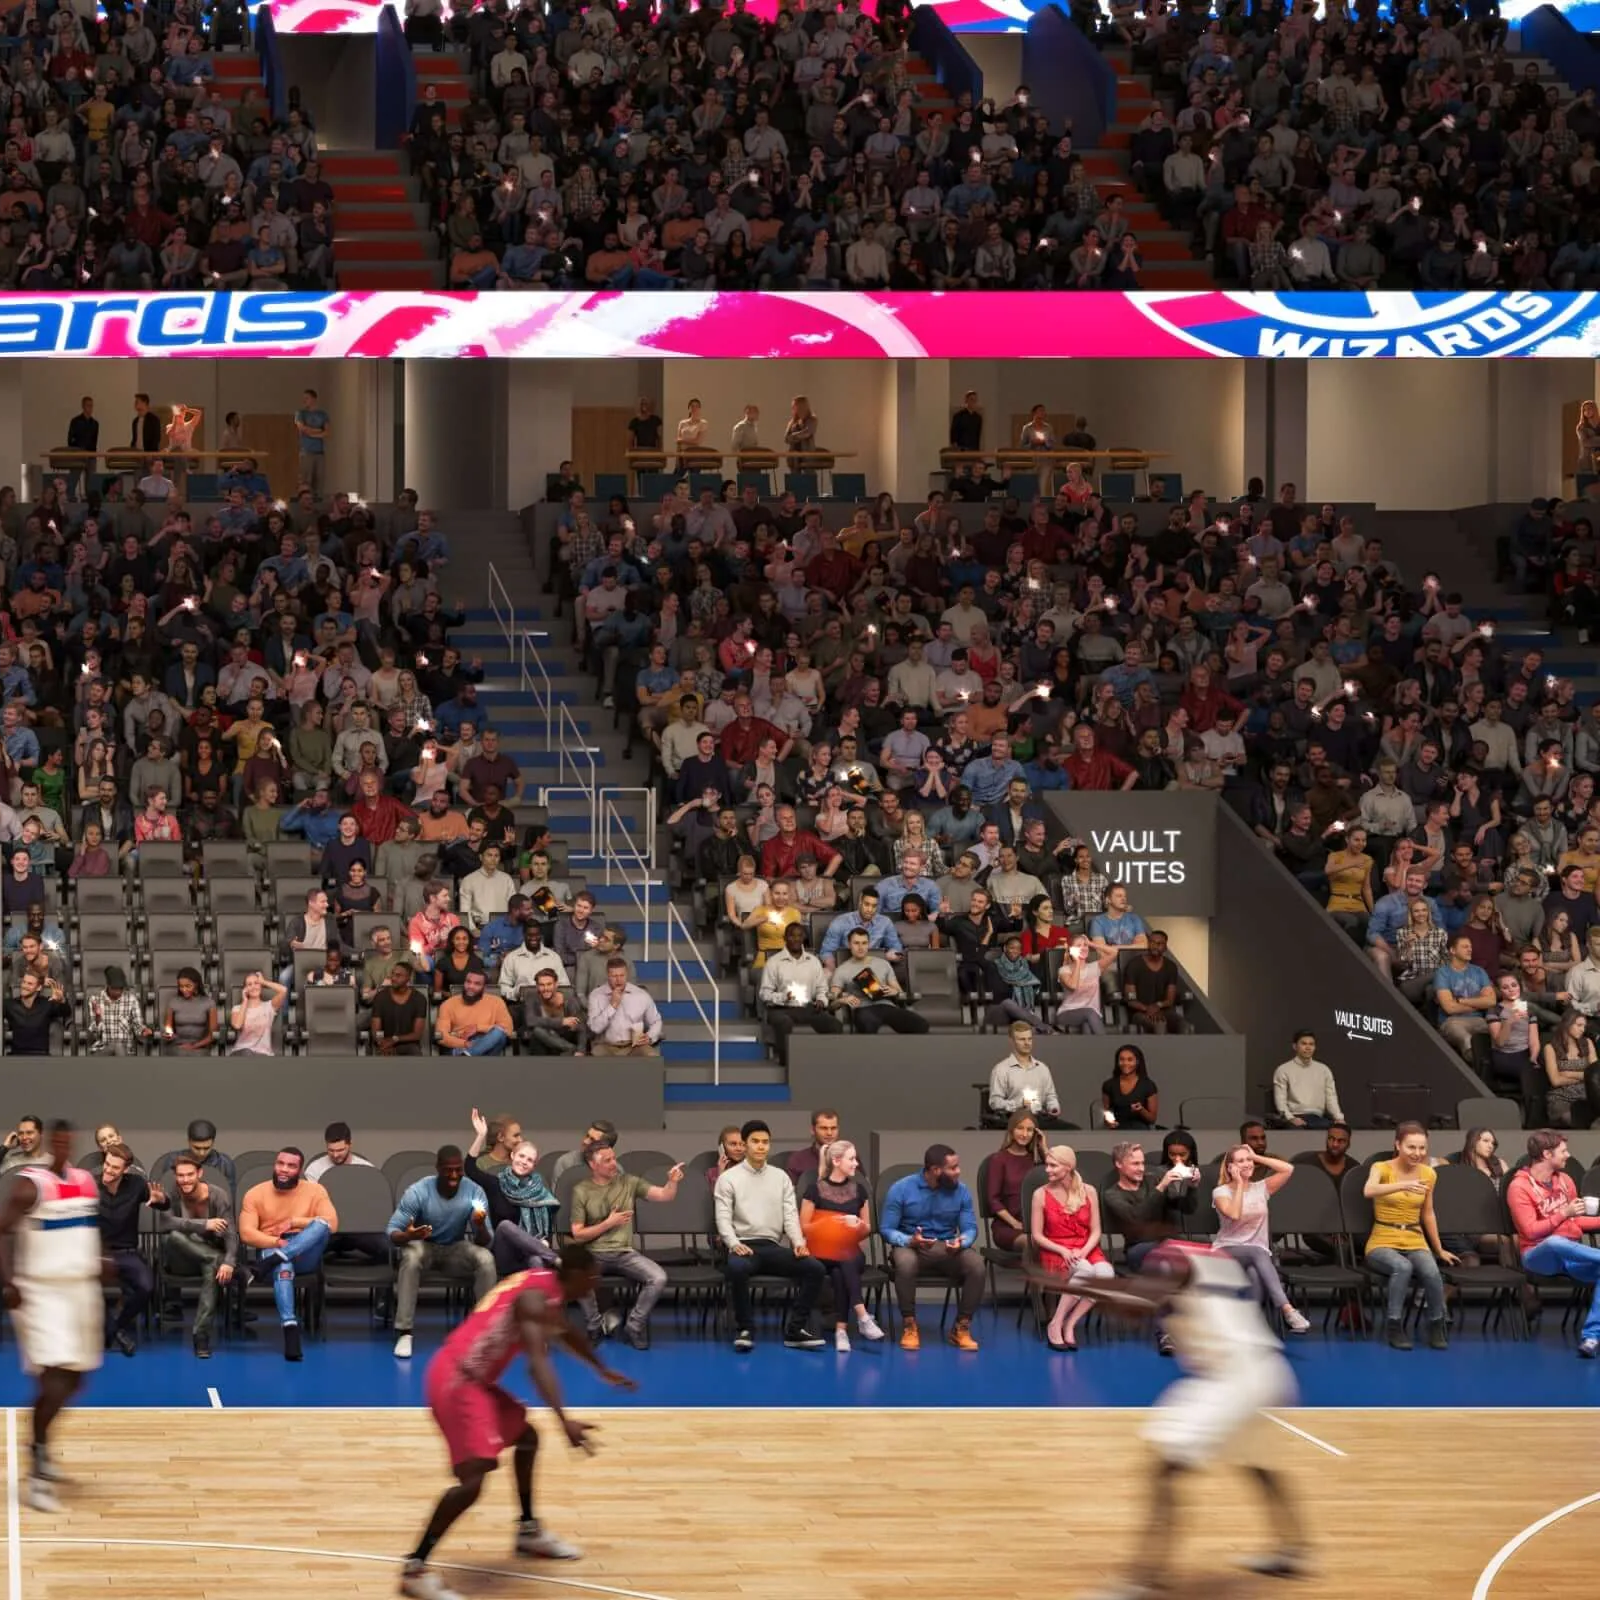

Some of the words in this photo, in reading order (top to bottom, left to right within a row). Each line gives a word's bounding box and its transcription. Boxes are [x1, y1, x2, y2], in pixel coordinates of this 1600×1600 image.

[1257, 291, 1553, 357] WIZARDS
[1090, 830, 1182, 853] VAULT
[1105, 861, 1186, 884] UITES
[1335, 1009, 1361, 1029] VAULT
[1362, 1015, 1393, 1036] SUITES
